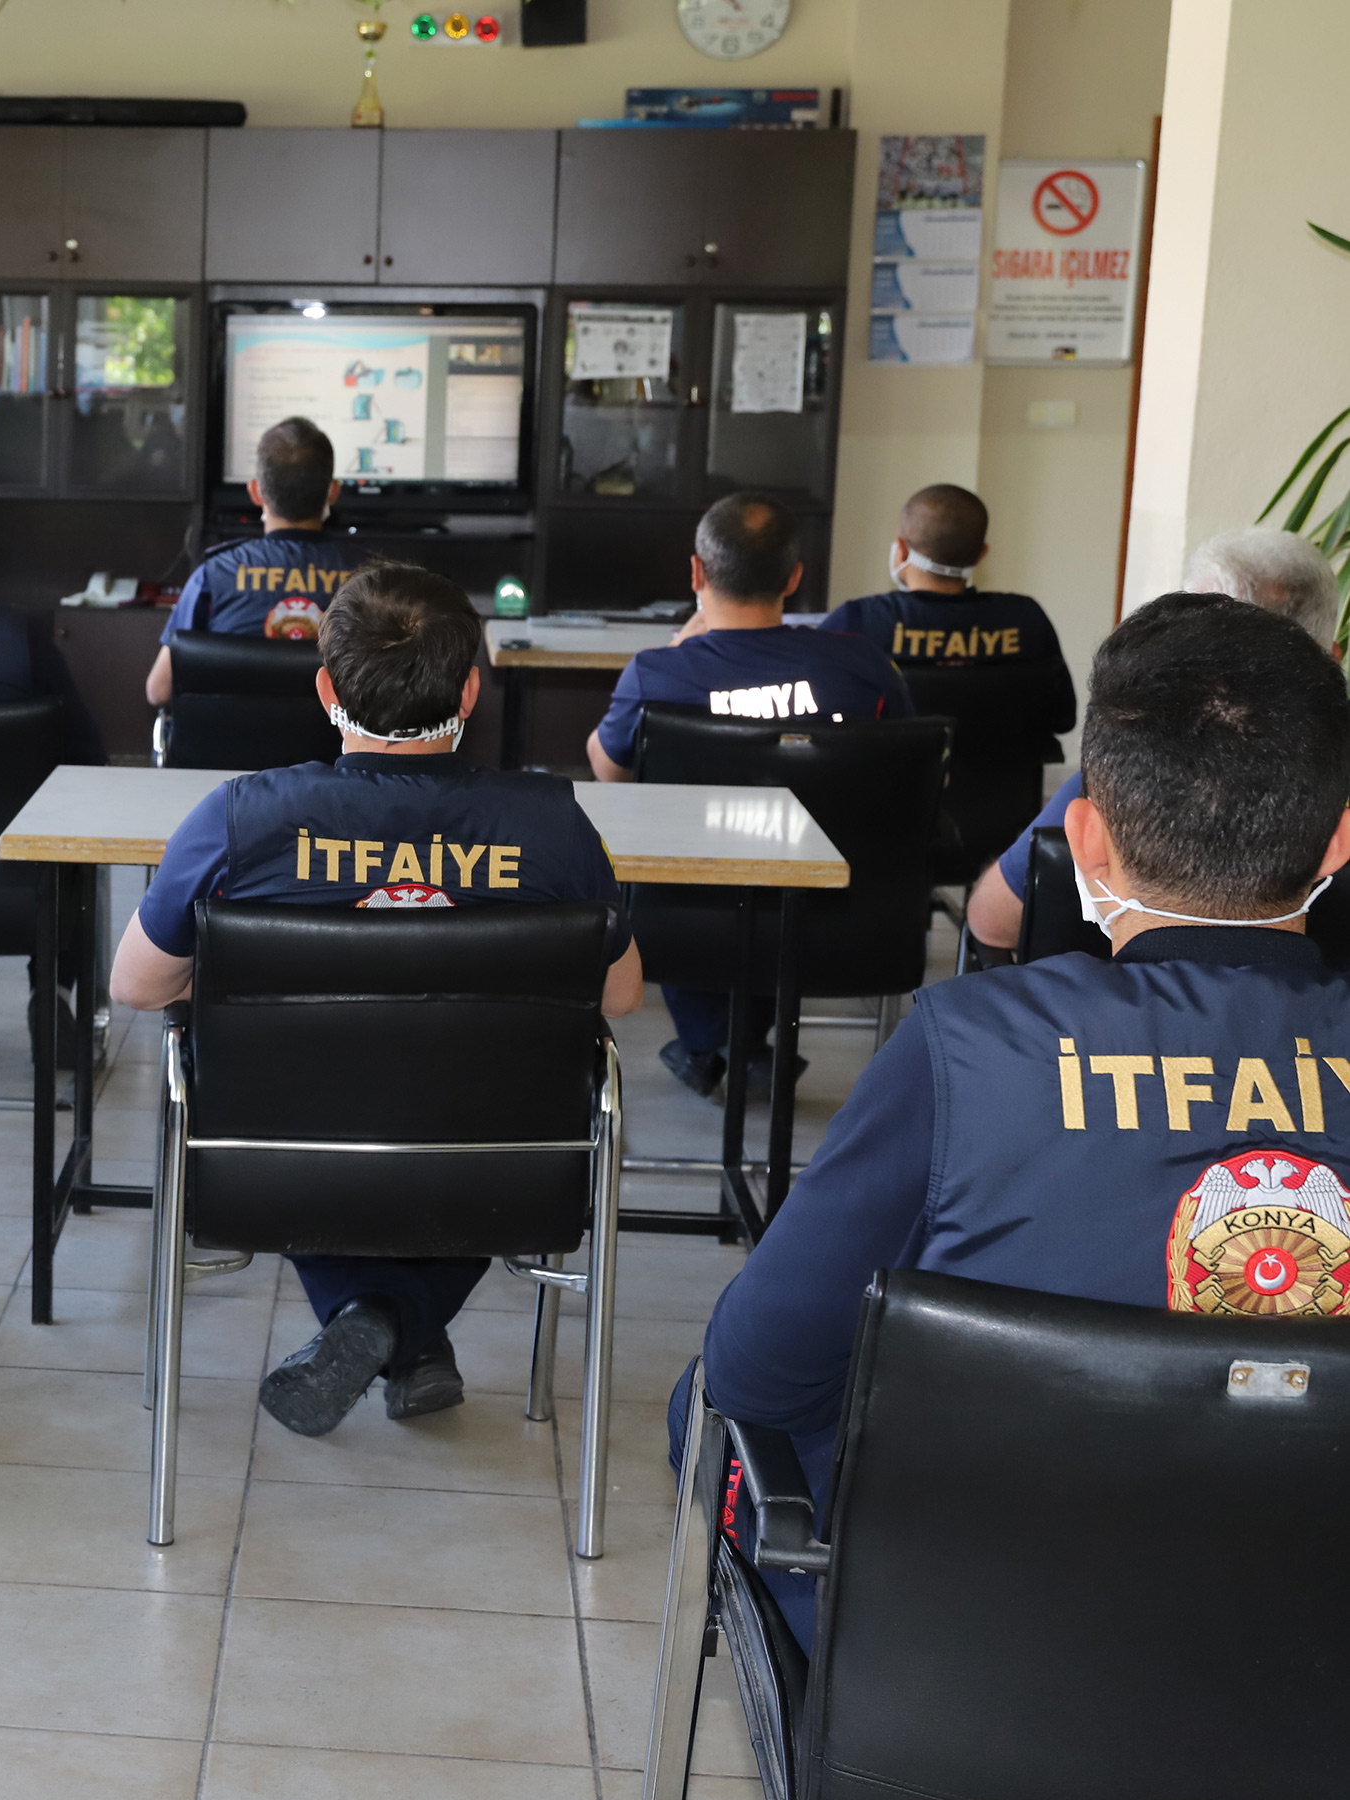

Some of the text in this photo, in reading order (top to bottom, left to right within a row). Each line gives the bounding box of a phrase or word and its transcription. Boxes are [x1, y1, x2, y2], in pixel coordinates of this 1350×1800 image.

[892, 622, 1020, 657] İTFAİYE
[297, 827, 522, 888] İTFAİYE
[1223, 1210, 1317, 1235] KONYA
